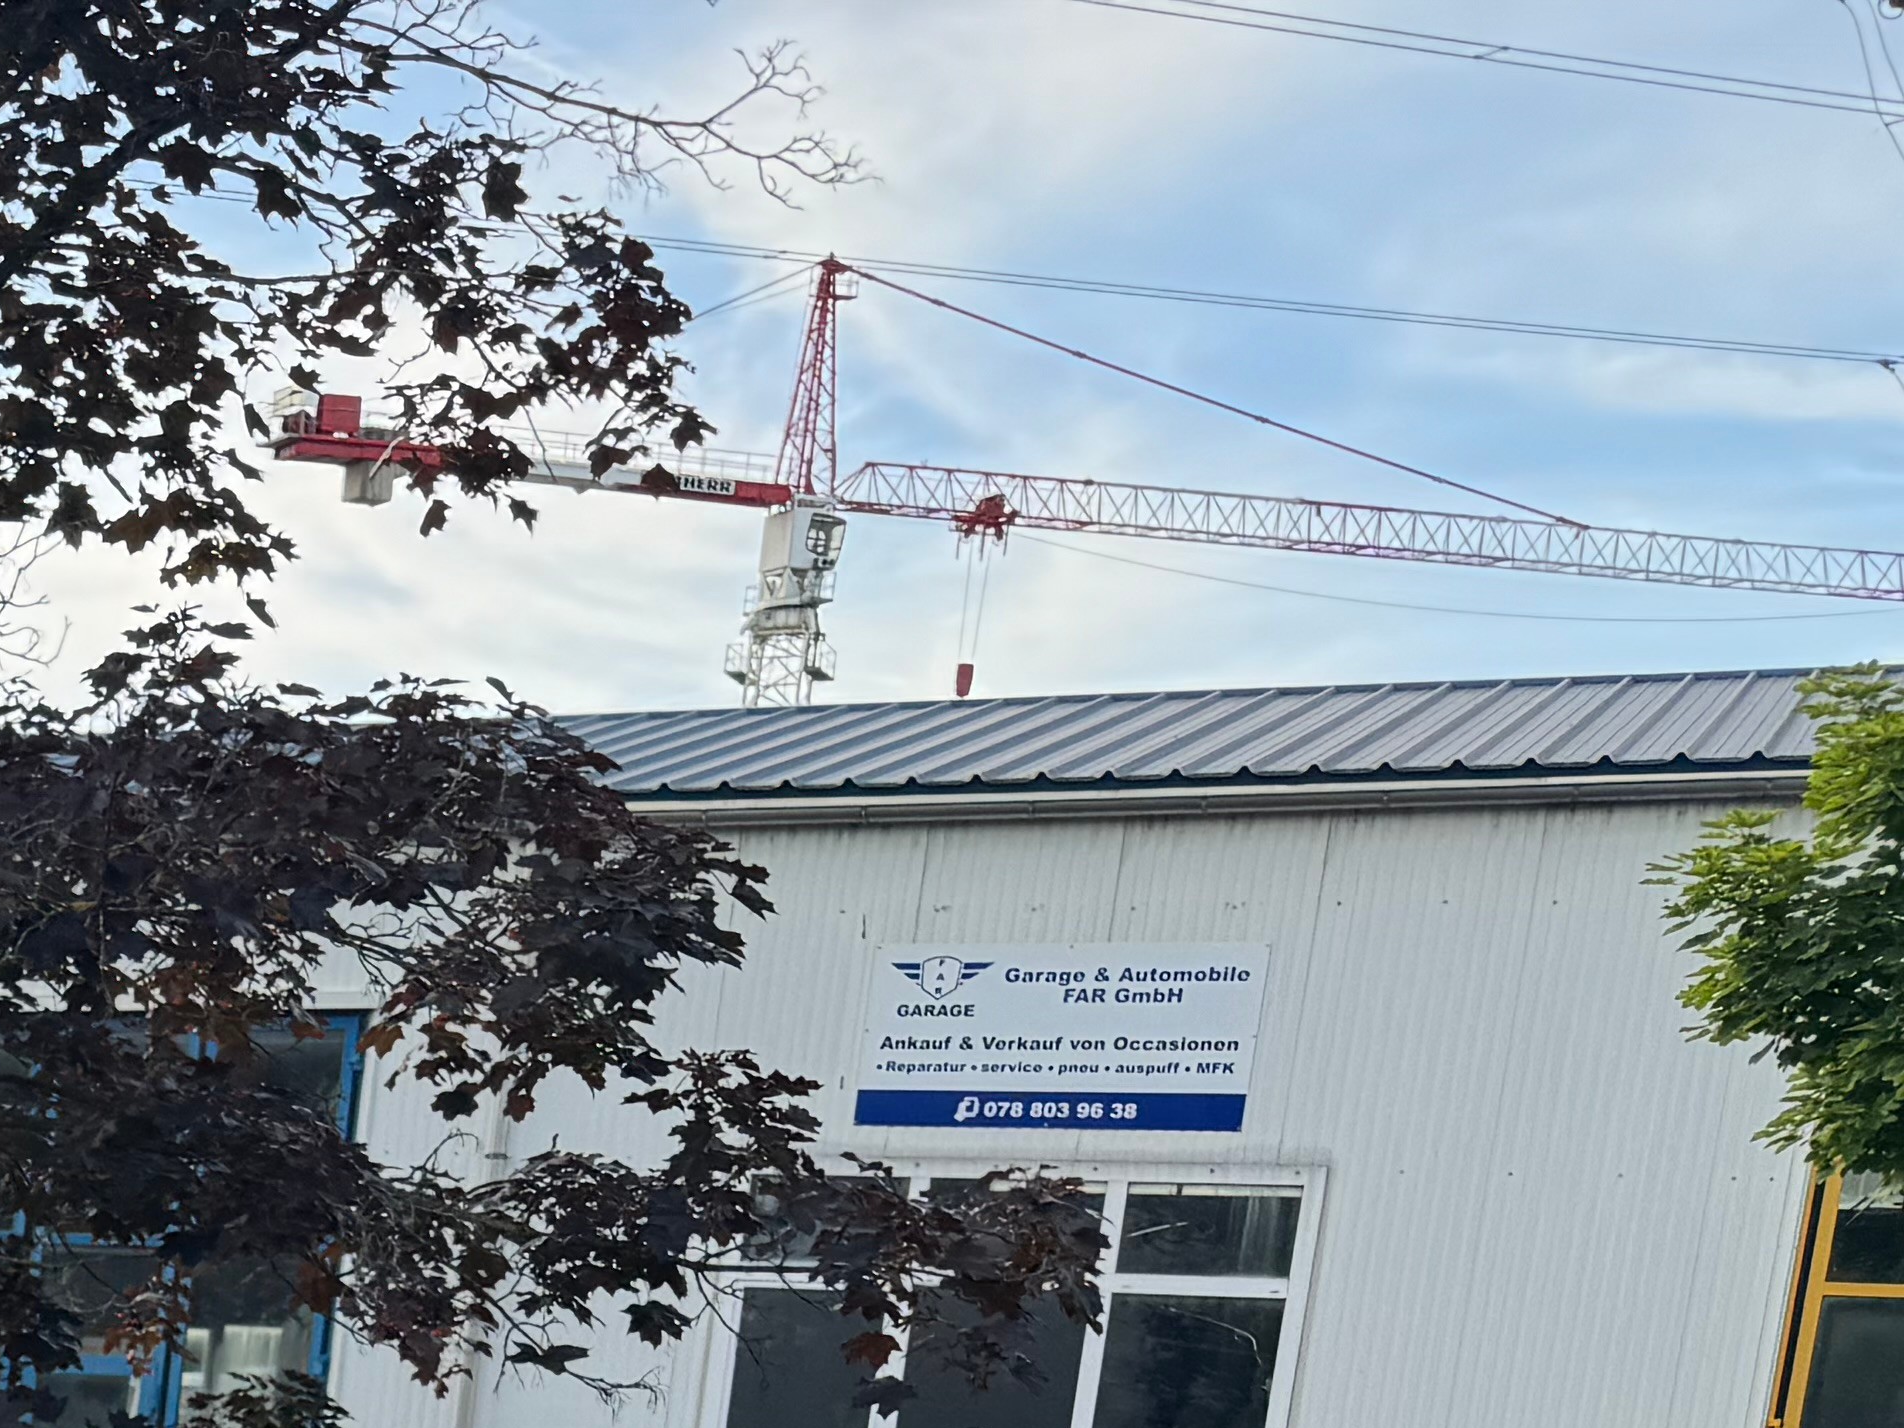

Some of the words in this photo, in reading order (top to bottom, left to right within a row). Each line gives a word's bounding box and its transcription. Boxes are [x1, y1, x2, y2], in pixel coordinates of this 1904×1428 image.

[1004, 967, 1086, 987] Garage
[1094, 967, 1110, 983] &
[1118, 966, 1251, 982] Automobile
[1063, 988, 1106, 1004] FAR
[1114, 987, 1184, 1004] GmbH
[896, 1004, 975, 1018] GARAGE
[879, 1035, 952, 1050] Ankauf
[959, 1036, 974, 1051] &
[982, 1036, 1064, 1051] Verkauf
[1069, 1039, 1106, 1051] von
[1113, 1036, 1239, 1052] Occasionen
[885, 1060, 967, 1075] Reparatur
[981, 1061, 1043, 1073] service
[1057, 1064, 1099, 1076] pneu
[1114, 1062, 1180, 1077] auspuff
[1196, 1062, 1235, 1074] MFK
[983, 1101, 1024, 1118] 078
[1029, 1101, 1070, 1118] 803
[1076, 1102, 1104, 1119] 96
[1109, 1102, 1138, 1120] 38
